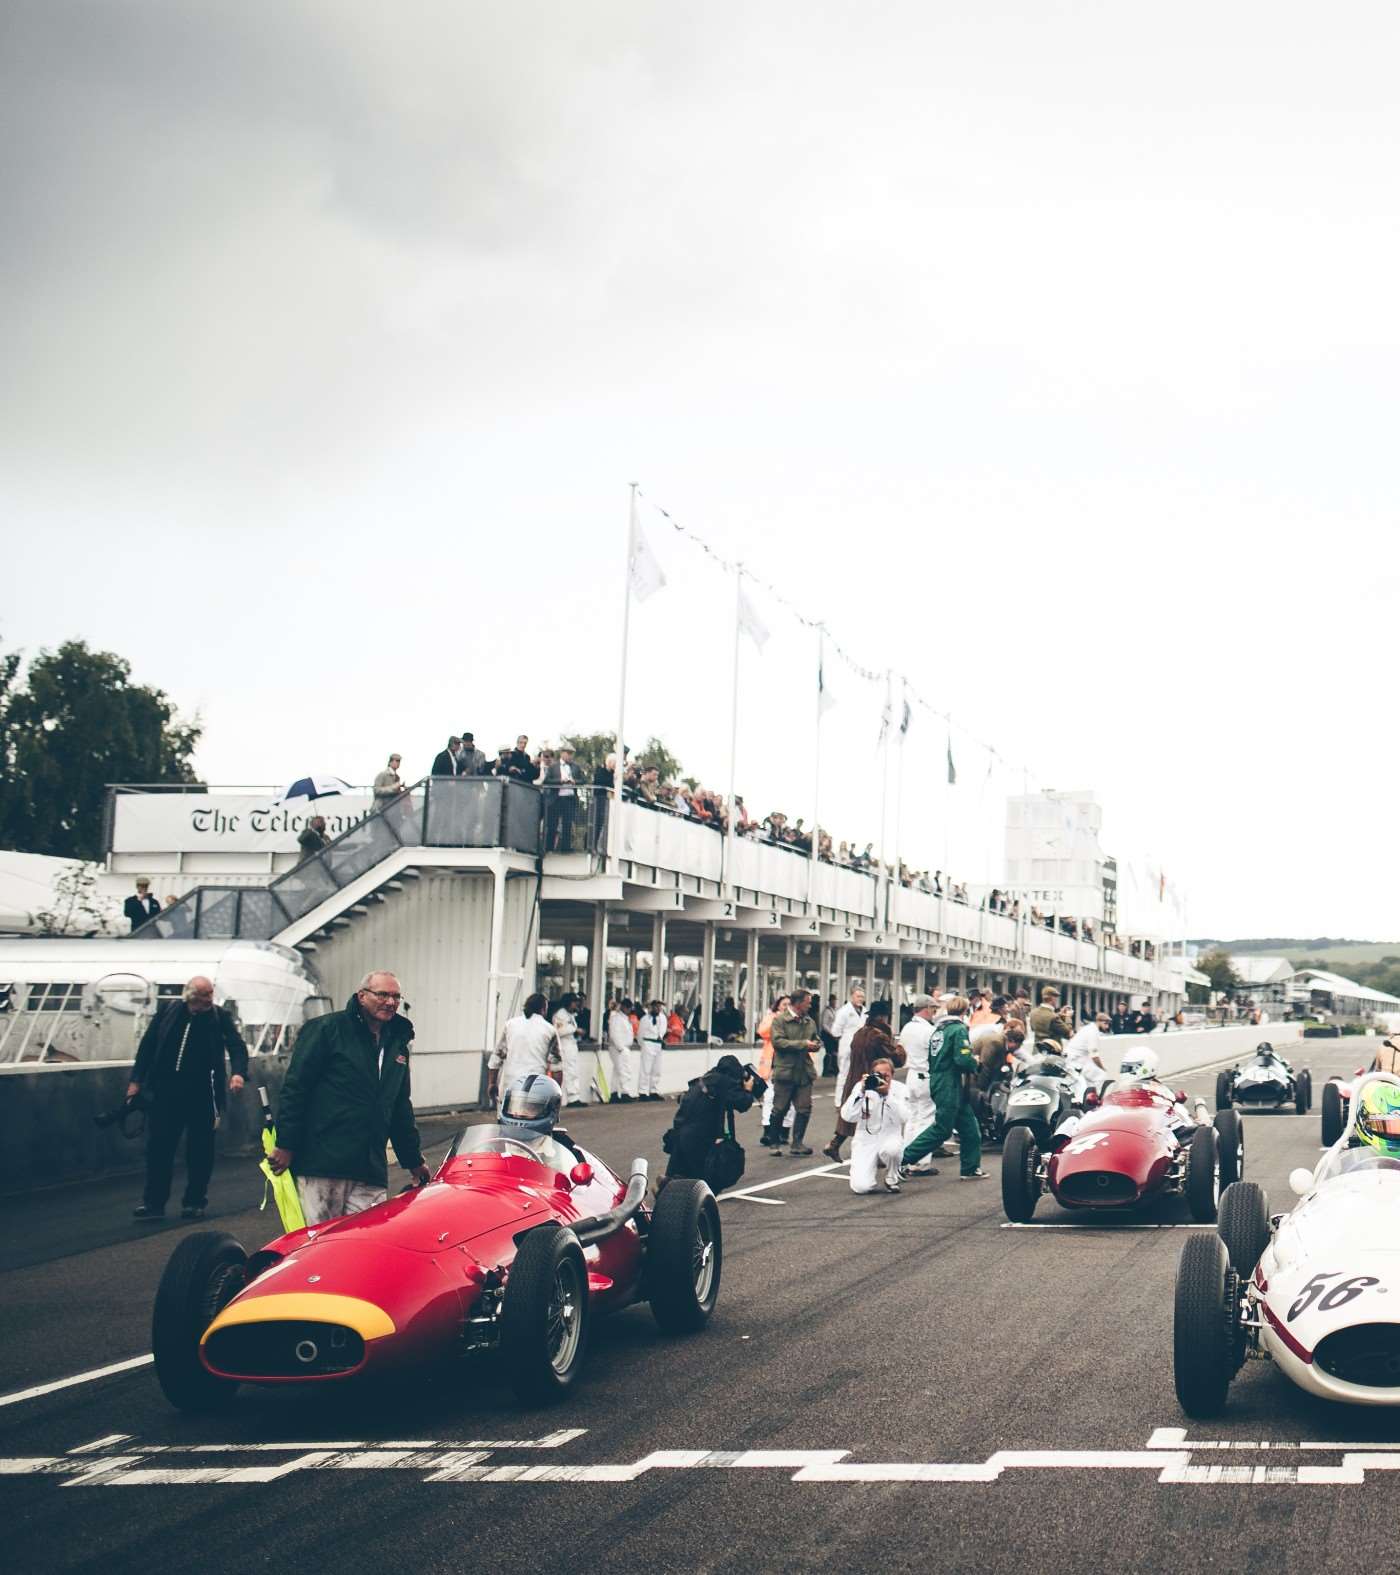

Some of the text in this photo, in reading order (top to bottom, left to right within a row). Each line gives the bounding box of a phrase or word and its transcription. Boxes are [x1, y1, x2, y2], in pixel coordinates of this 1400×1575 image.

[190, 808, 367, 836] The Teleap
[724, 903, 733, 916] 2
[769, 912, 777, 925] 3
[808, 920, 817, 931] 4
[844, 928, 852, 938] 5
[875, 934, 883, 944] 6
[916, 942, 923, 951] 7
[940, 946, 948, 955] 8
[963, 951, 970, 959] 9
[1286, 1271, 1381, 1323] 56
